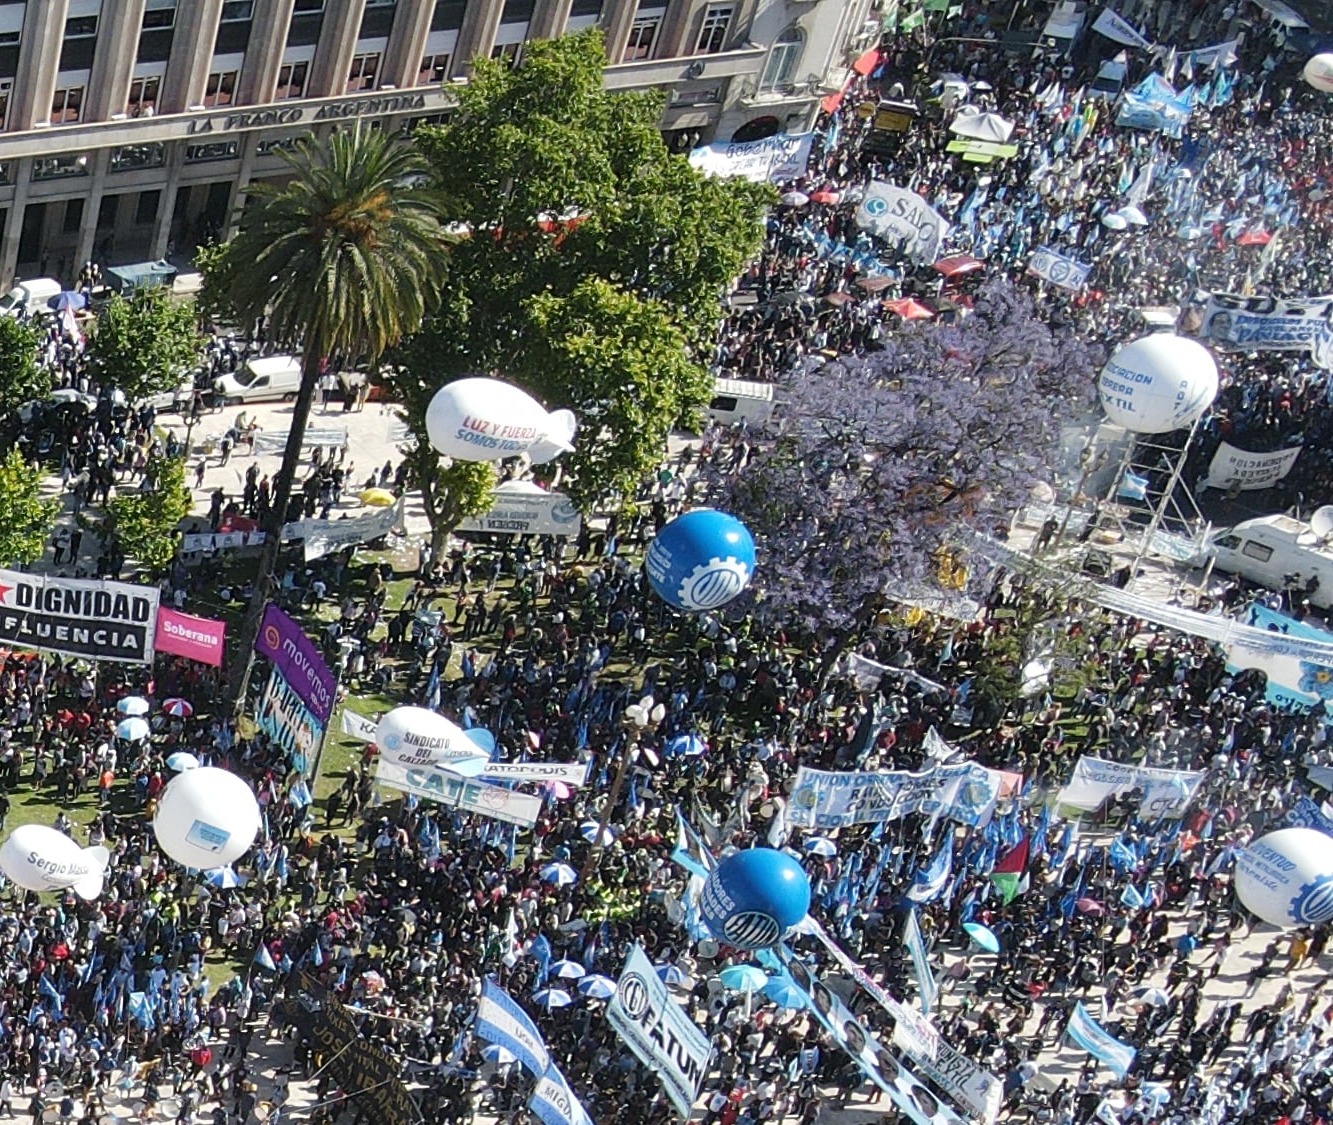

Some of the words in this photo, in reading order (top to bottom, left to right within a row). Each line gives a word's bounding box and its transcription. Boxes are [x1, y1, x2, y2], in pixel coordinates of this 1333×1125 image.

[187, 118, 213, 134] LA
[223, 108, 303, 131] FRANCO
[313, 95, 427, 120] ARGENTINA
[462, 415, 490, 434] LUZ
[492, 422, 501, 435] Y
[454, 428, 497, 450] SOMOS
[15, 581, 151, 623] DIGNIDAD
[163, 620, 219, 646] Soberana
[282, 637, 331, 710] movemos
[403, 731, 451, 750] SINDICATO
[406, 767, 482, 803] CATE
[26, 851, 67, 876] Sergio
